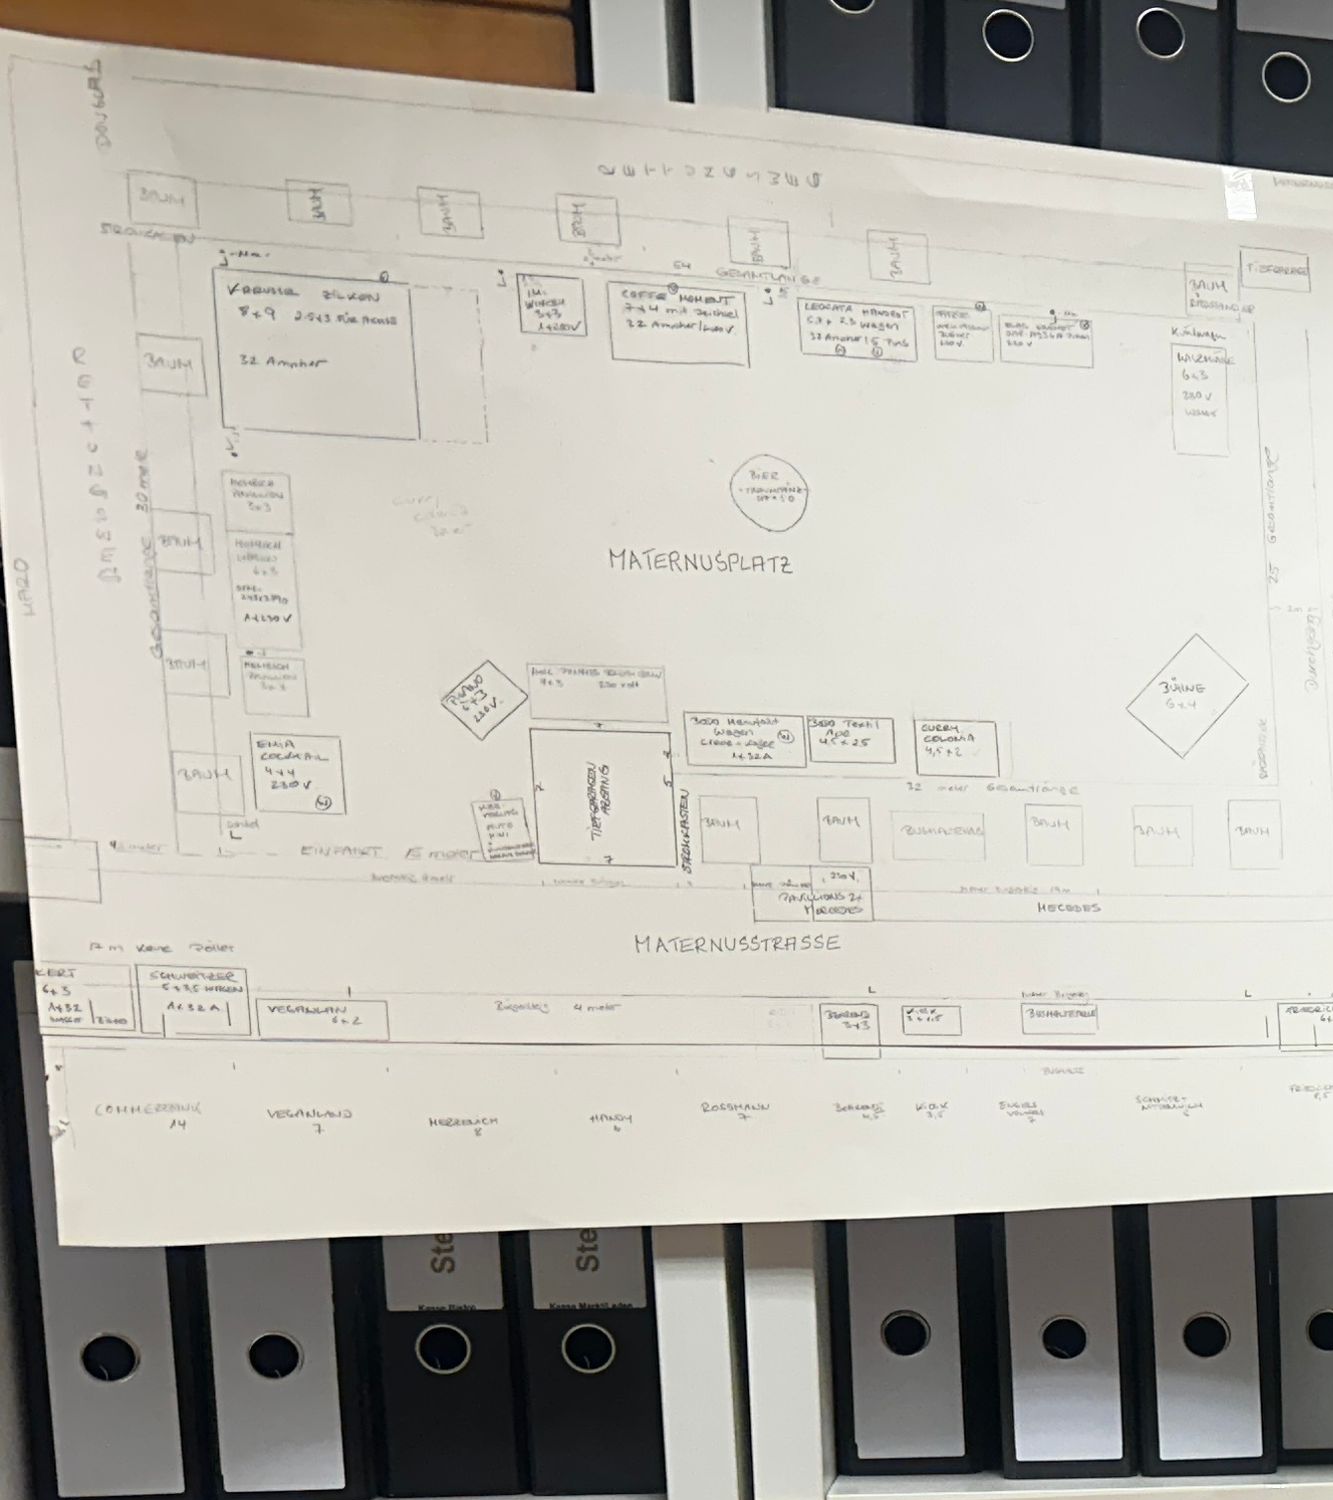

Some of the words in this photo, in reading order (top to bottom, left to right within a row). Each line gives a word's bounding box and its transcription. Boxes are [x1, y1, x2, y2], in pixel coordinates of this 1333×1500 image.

[608, 547, 794, 575] MATERNUSPLATZ
[634, 933, 842, 953] MATERNUSSTRASSE
[701, 1101, 771, 1114] ROSSMANN
[431, 1233, 456, 1274] Ste
[576, 1229, 600, 1272] Ste
